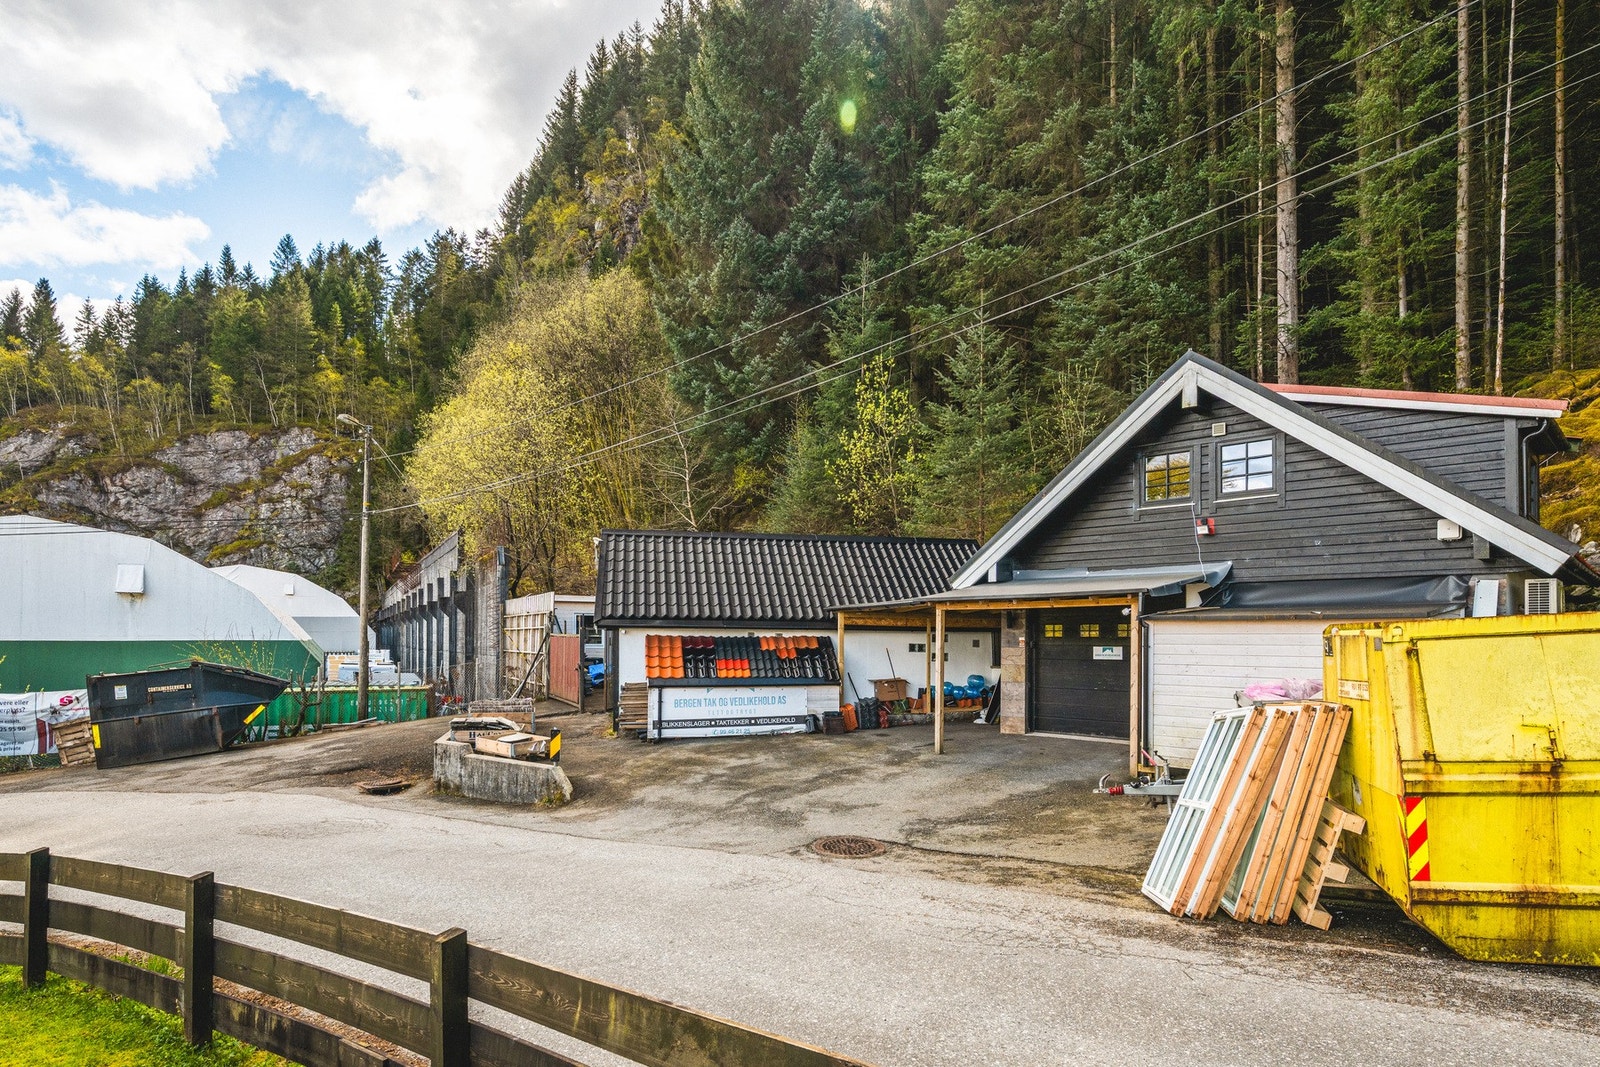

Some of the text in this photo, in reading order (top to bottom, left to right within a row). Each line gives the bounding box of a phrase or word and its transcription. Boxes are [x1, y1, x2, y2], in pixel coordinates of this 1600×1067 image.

[674, 695, 787, 708] BERGEN TAK OG VEDLIKEHOLD AS
[716, 718, 750, 726] TAKTEKKER
